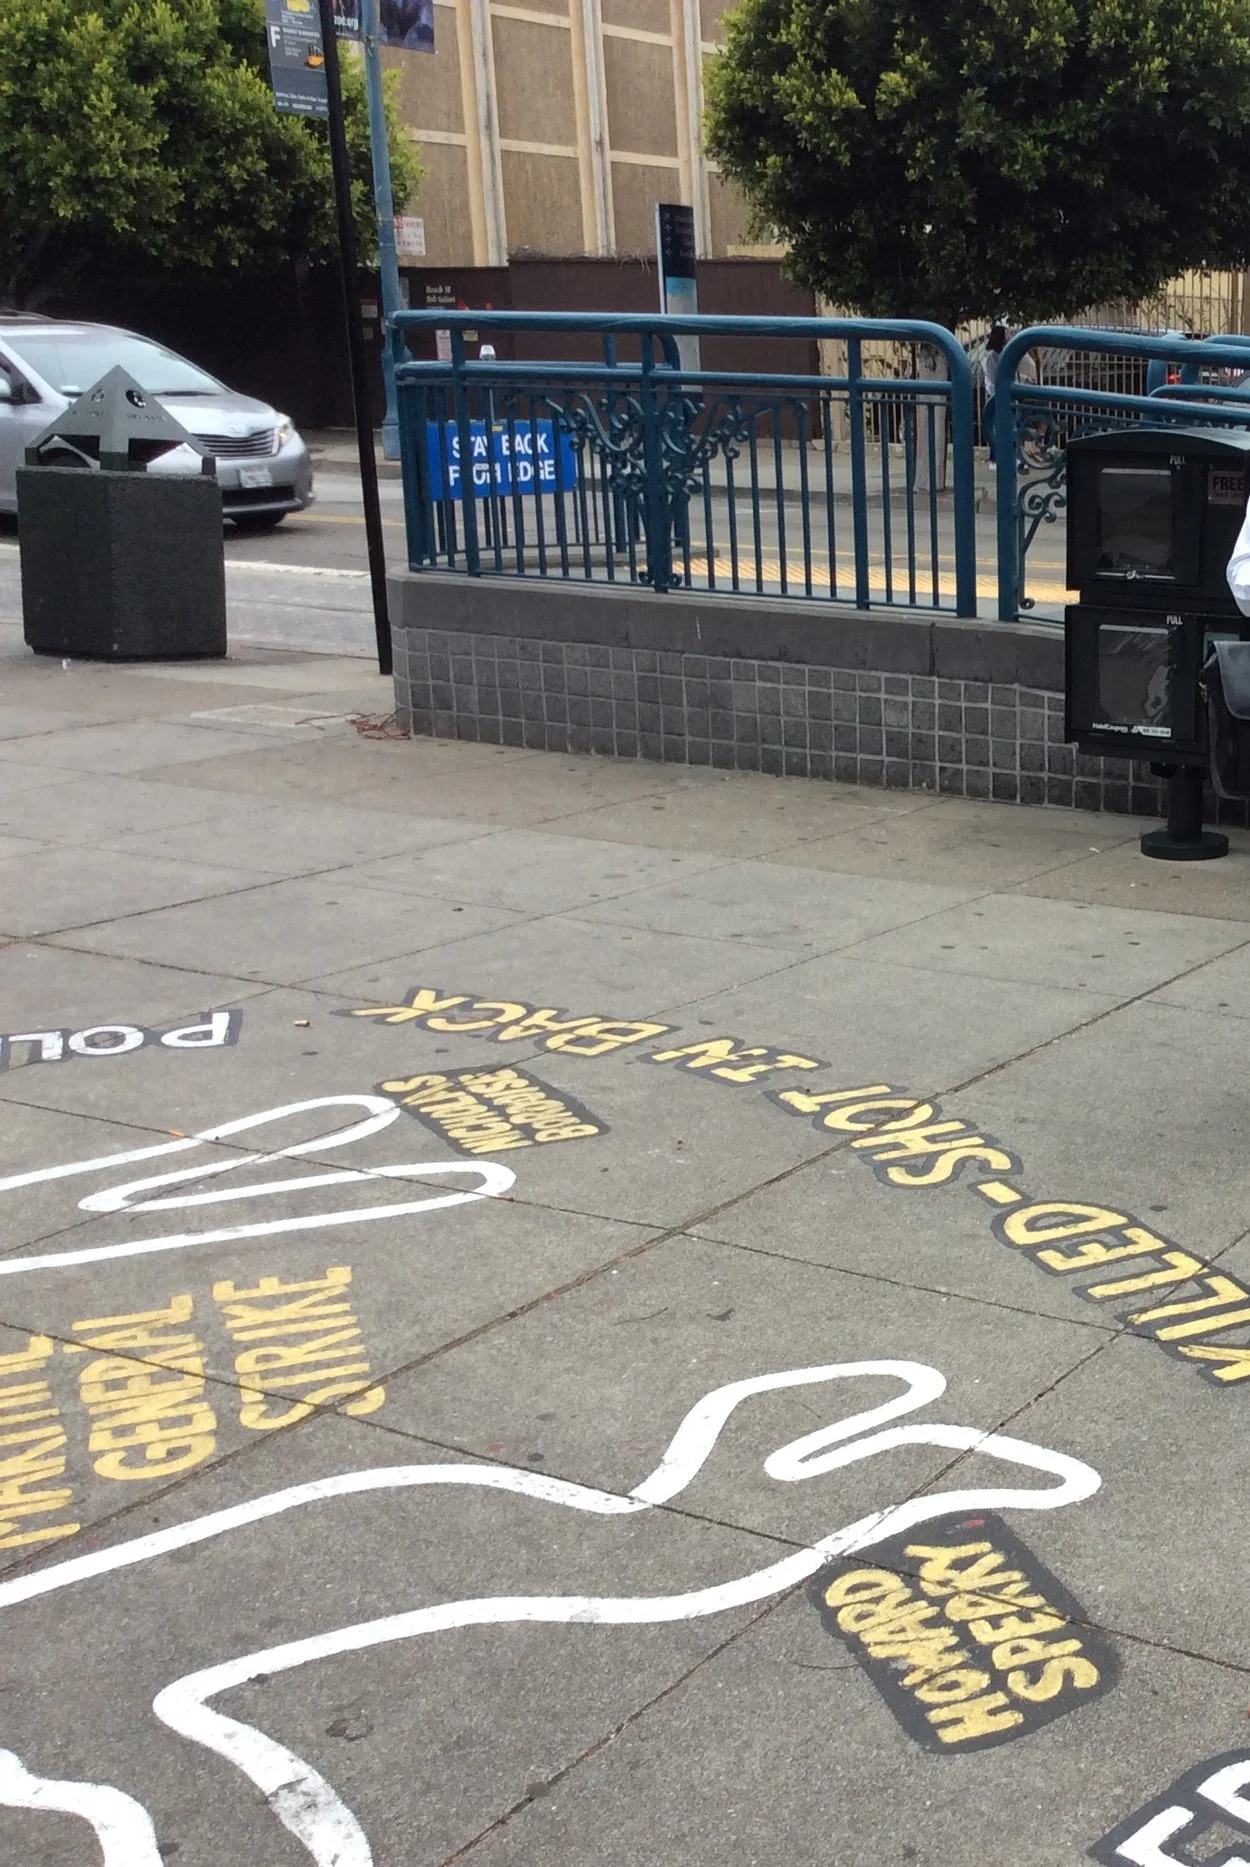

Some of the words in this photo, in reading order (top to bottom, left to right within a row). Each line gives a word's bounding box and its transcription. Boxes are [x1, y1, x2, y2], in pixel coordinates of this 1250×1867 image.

[270, 25, 282, 48] F
[448, 461, 502, 487] FOM
[452, 435, 489, 459] SA
[1212, 476, 1245, 491] FREE
[1166, 615, 1183, 625] PULL
[350, 989, 669, 1057] BACK
[653, 1039, 819, 1083] IN
[381, 1074, 534, 1154] NICHOLAS
[778, 1084, 1012, 1186] SHOT
[212, 1265, 386, 1430] STRIKE
[62, 1294, 218, 1481] GENERAL
[903, 1540, 1100, 1702] SPERRY
[824, 1568, 1024, 1743] HOWARD
